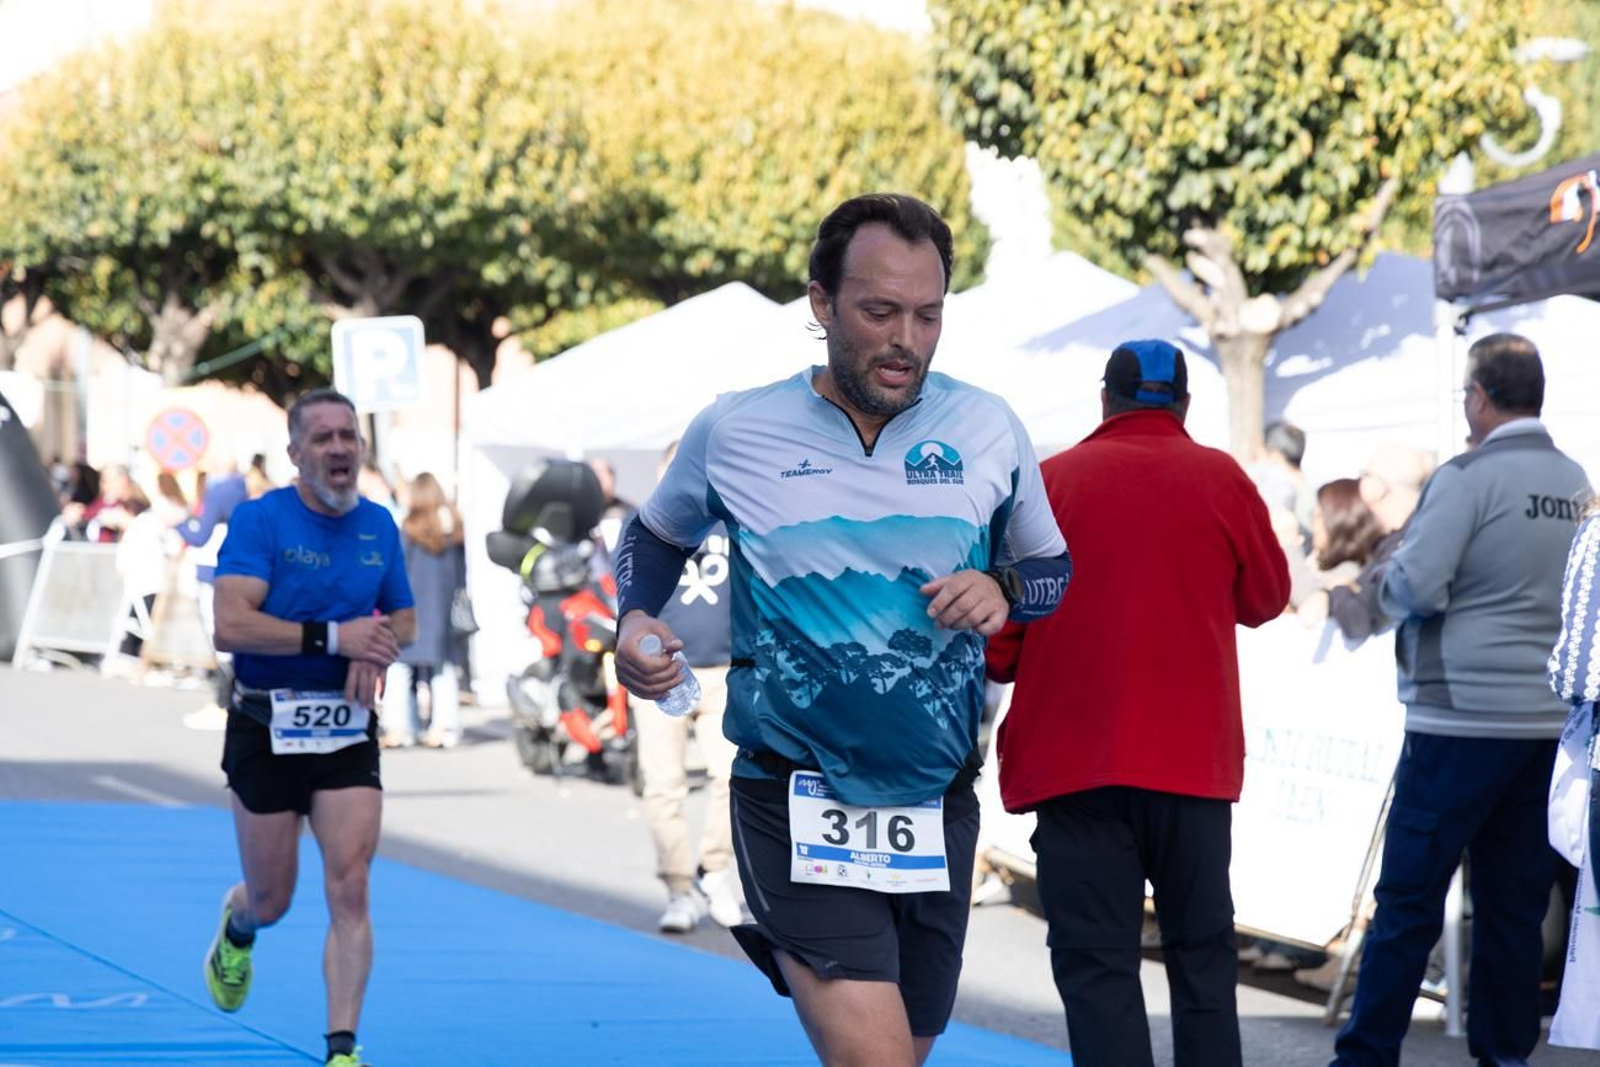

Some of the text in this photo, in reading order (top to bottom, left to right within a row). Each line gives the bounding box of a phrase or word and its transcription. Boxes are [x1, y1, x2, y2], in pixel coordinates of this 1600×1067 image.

[352, 330, 408, 401] P
[907, 470, 963, 479] ULTRA TRAIL
[293, 705, 351, 727] 520
[821, 809, 915, 853] 316
[850, 851, 891, 864] ALBERTO
